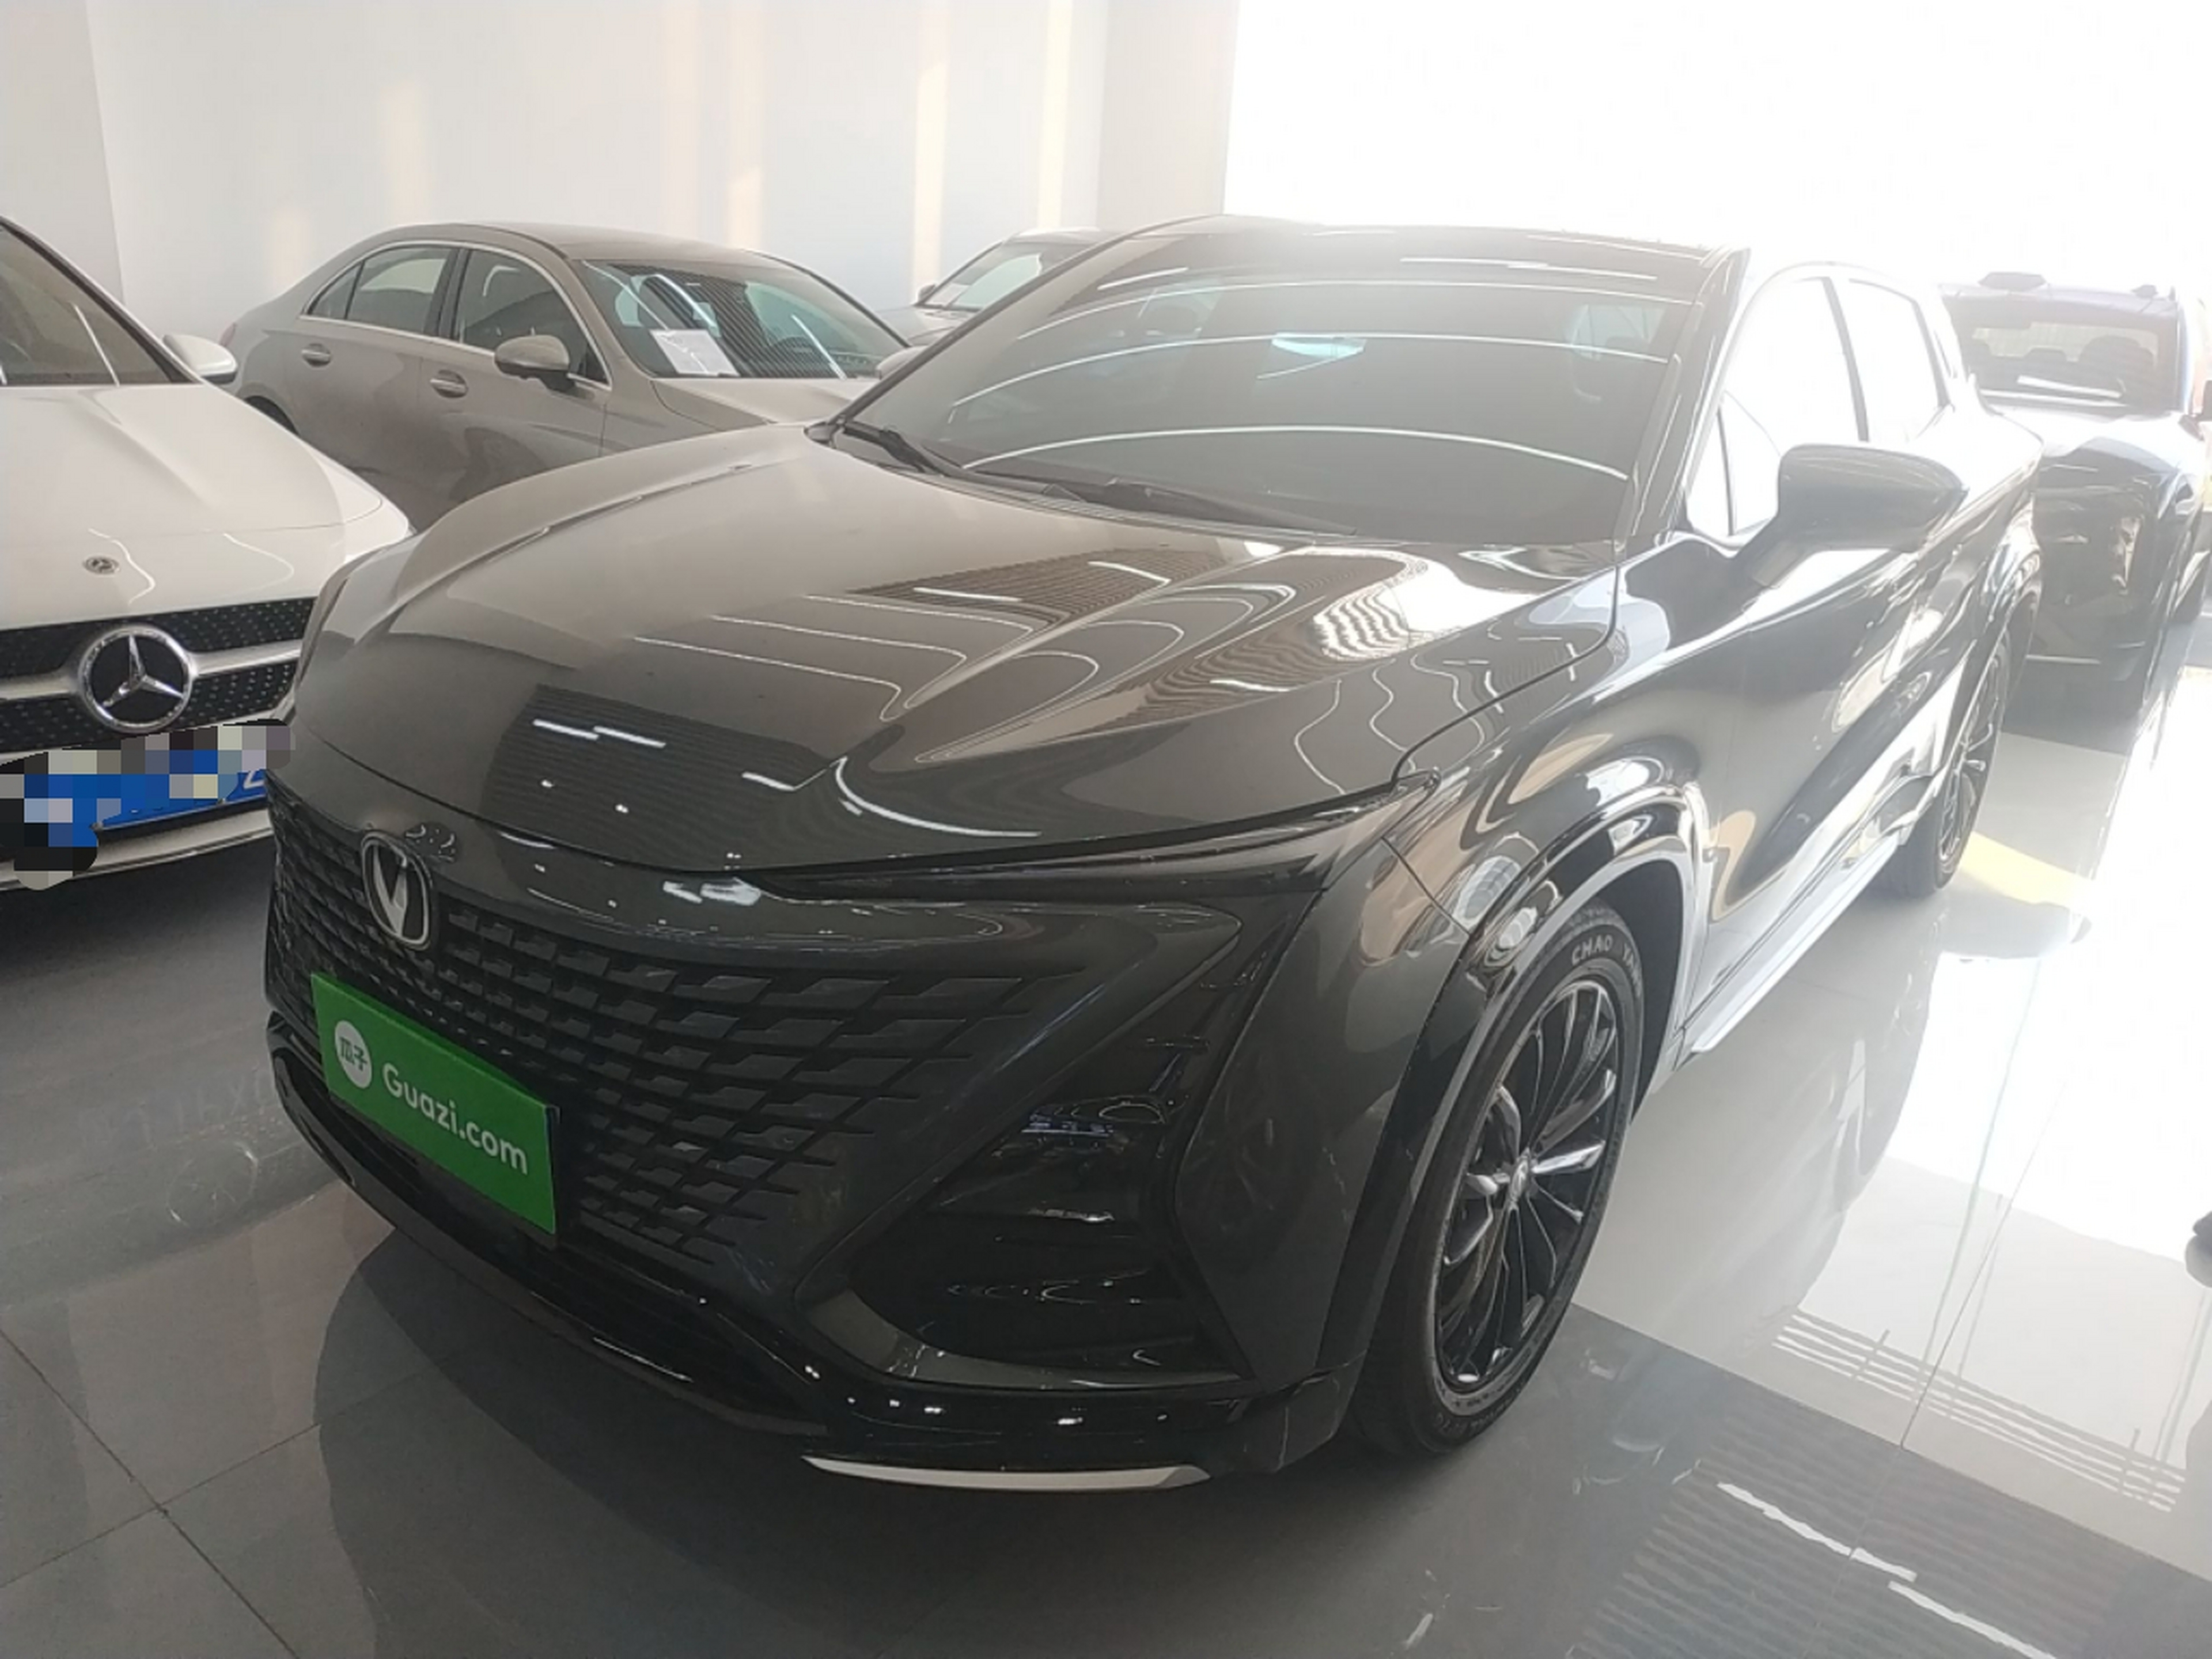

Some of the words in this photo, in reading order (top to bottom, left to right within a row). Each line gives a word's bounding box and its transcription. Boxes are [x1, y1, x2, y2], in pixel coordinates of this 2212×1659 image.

[1571, 934, 1612, 966] CHAO
[339, 1036, 368, 1071] 瓜子
[382, 1063, 528, 1175] Guazi.com
